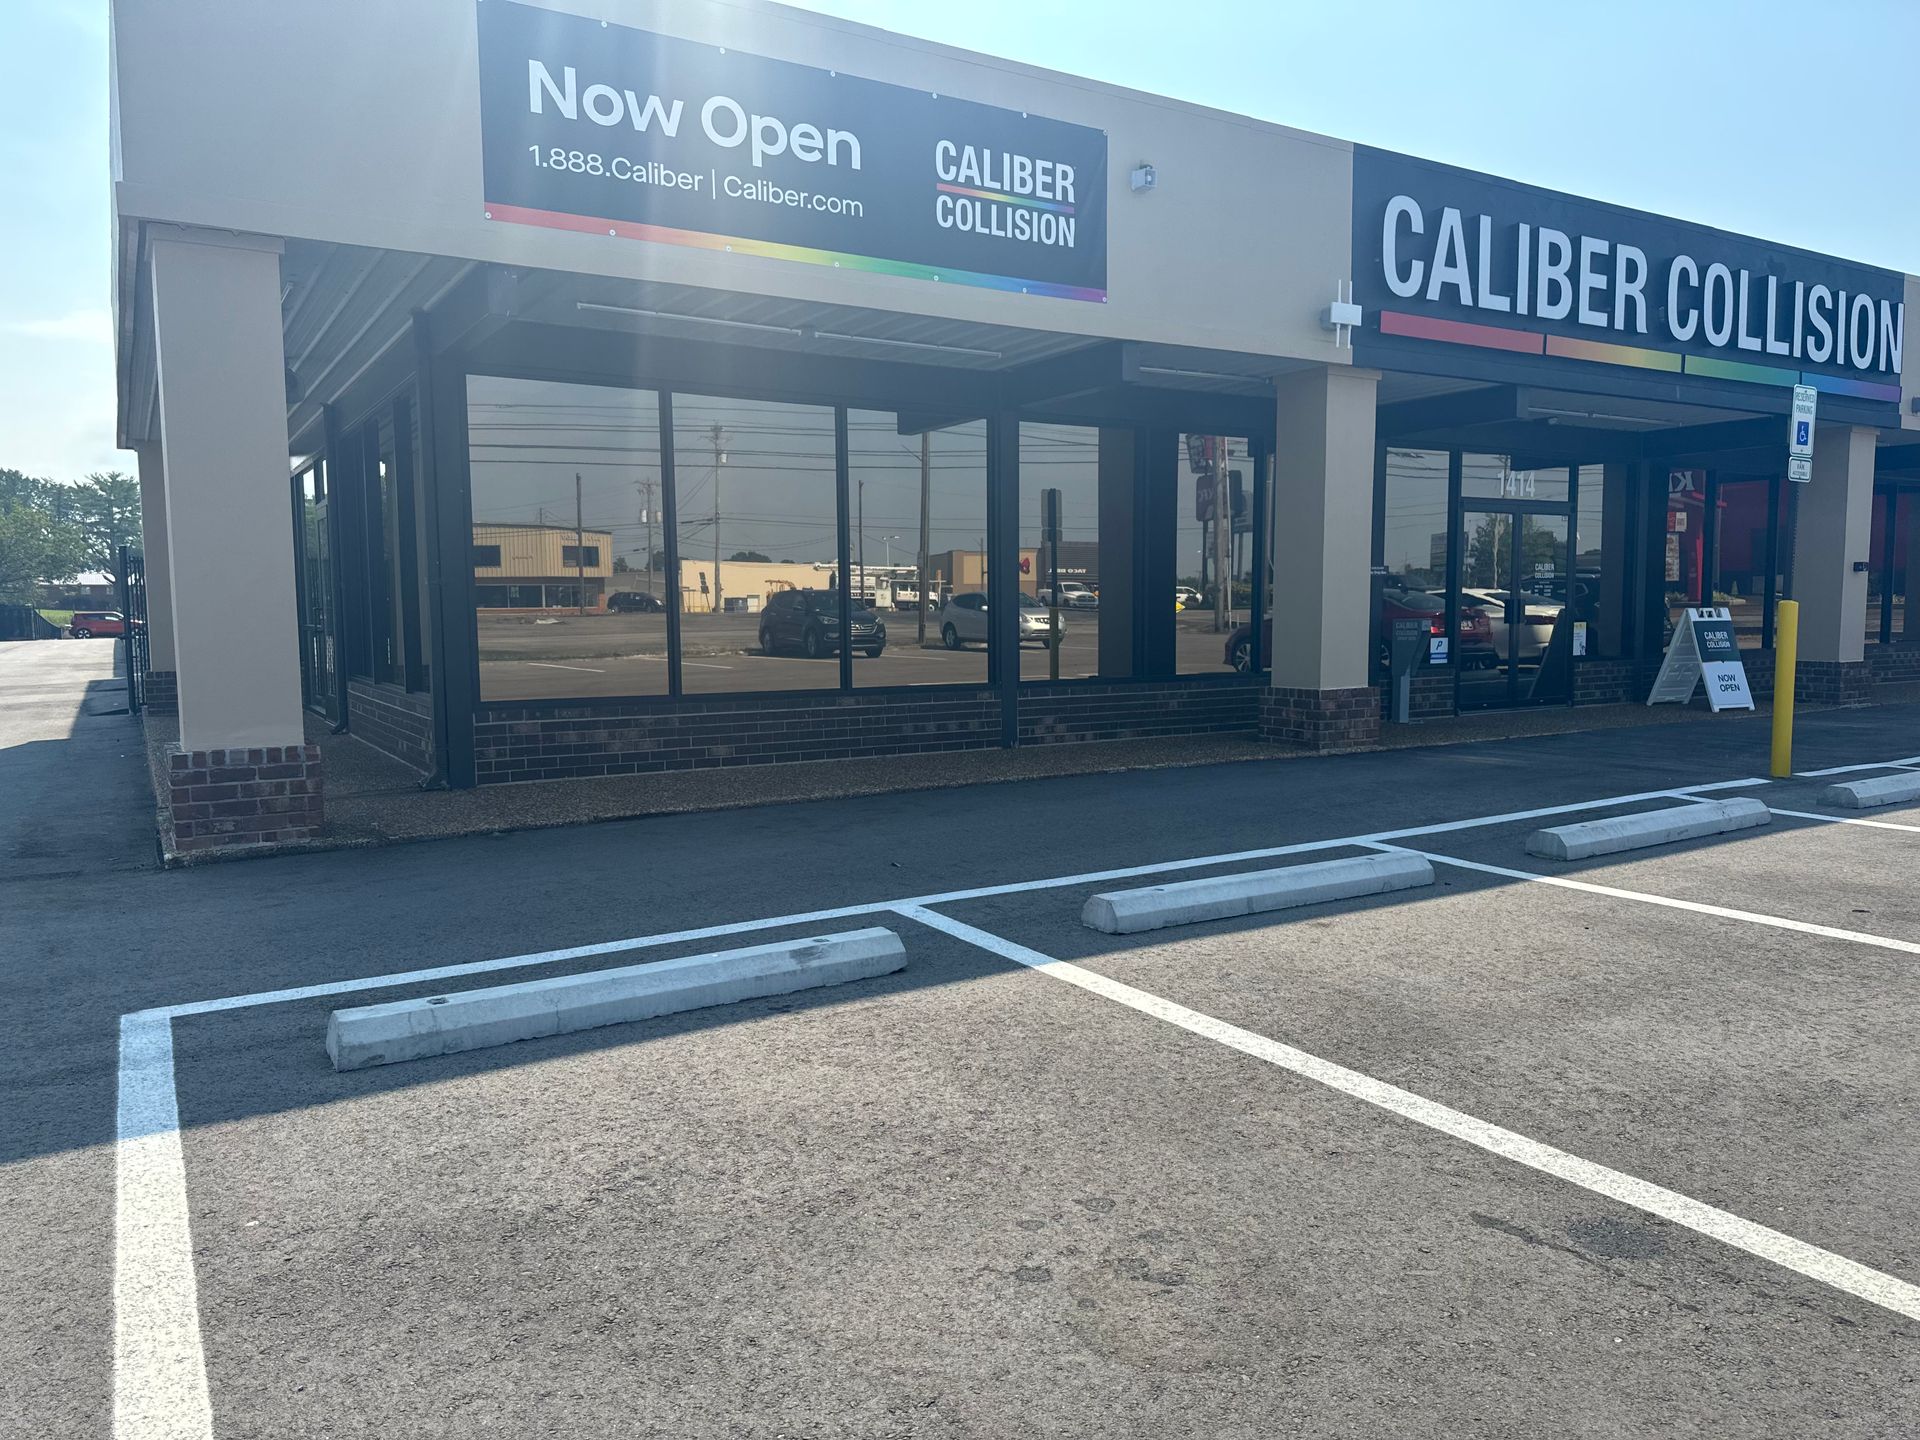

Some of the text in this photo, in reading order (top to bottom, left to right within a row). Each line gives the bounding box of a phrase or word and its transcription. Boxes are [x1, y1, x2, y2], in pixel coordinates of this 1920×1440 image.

[528, 59, 862, 170] Now Open
[528, 145, 864, 218] 1.888.Caliber Caliber.com
[935, 139, 1076, 204] CALIBER
[935, 194, 1076, 249] COLLISION
[1382, 195, 1905, 374] CALIBER COLLISION
[1795, 404, 1813, 415] PARKING
[1497, 470, 1536, 498] 1414
[1703, 631, 1729, 640] CALIBER
[1706, 640, 1731, 648] COLLISION
[1718, 674, 1736, 682] NOW
[1720, 684, 1740, 692] OPEN
